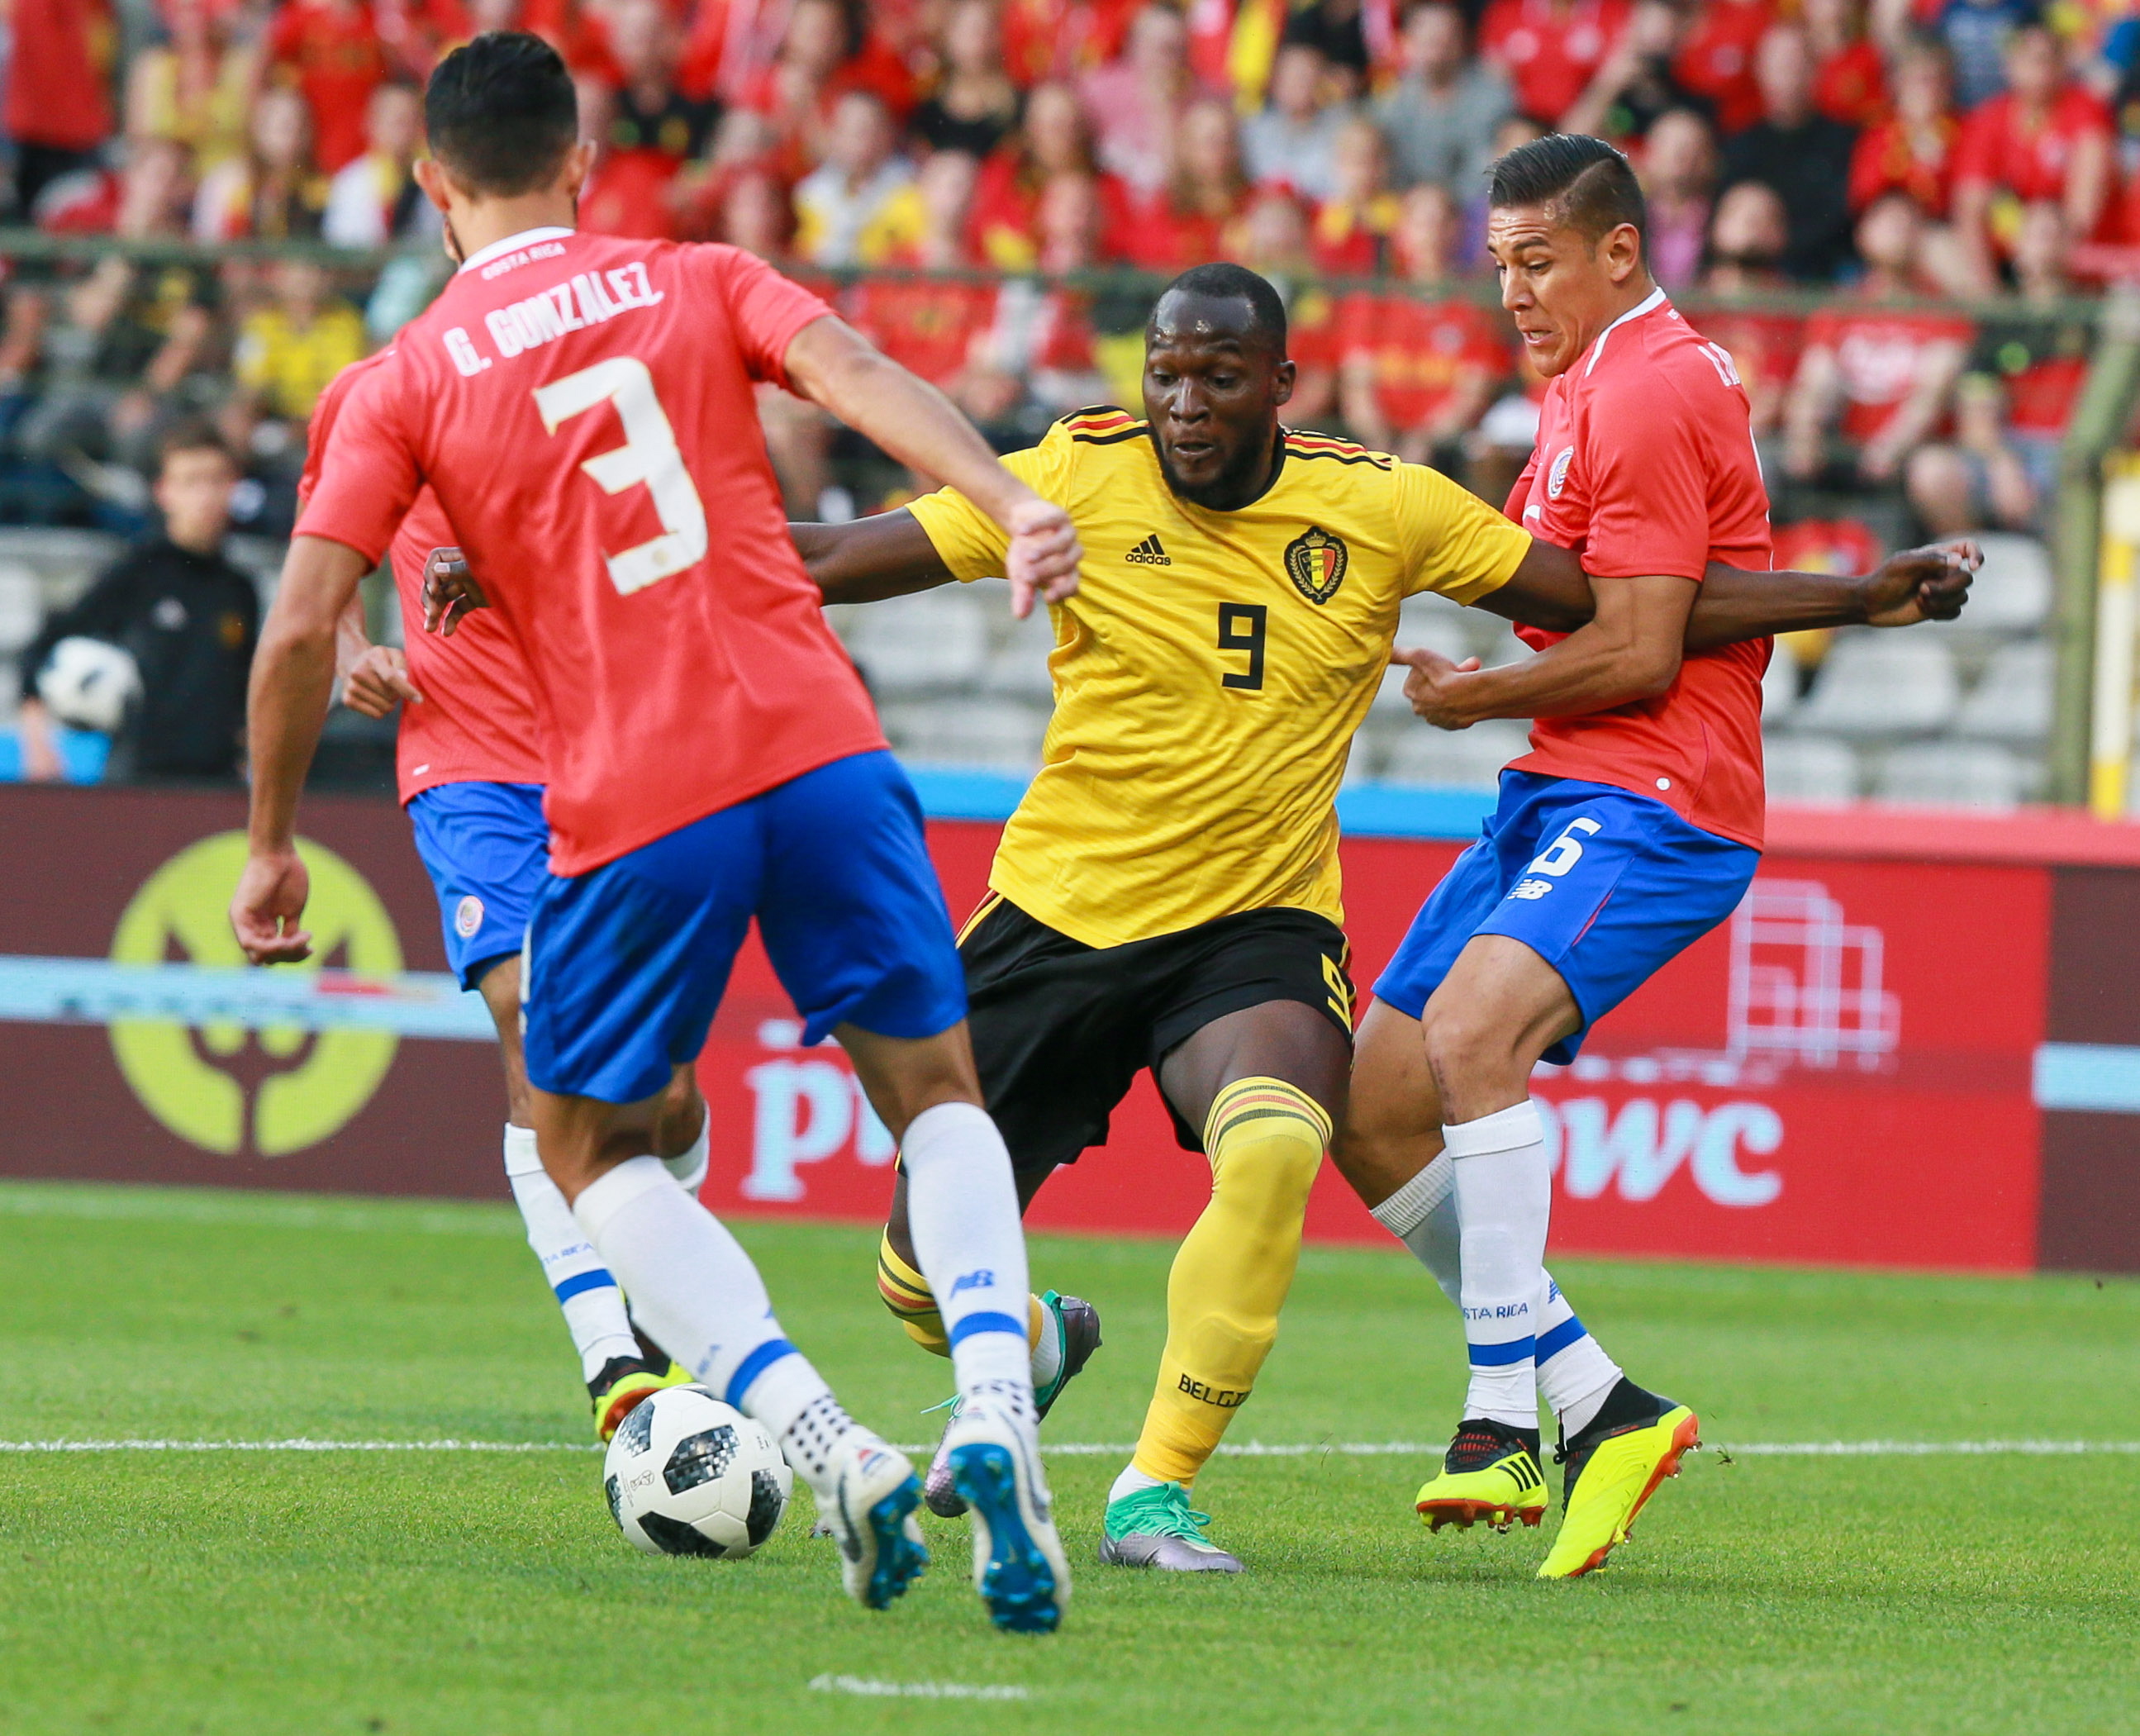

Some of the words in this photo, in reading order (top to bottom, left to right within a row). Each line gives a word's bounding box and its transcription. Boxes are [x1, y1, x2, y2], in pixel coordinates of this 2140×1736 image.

[443, 327, 492, 377] G.
[531, 355, 708, 596] 3
[1125, 553, 1171, 566] adidas
[1218, 602, 1267, 690] 9
[1526, 817, 1602, 877] 6
[1321, 953, 1352, 1034] 9
[739, 1058, 899, 1202] p
[1496, 1302, 1529, 1319] RICA
[1177, 1372, 1253, 1408] BELGI
